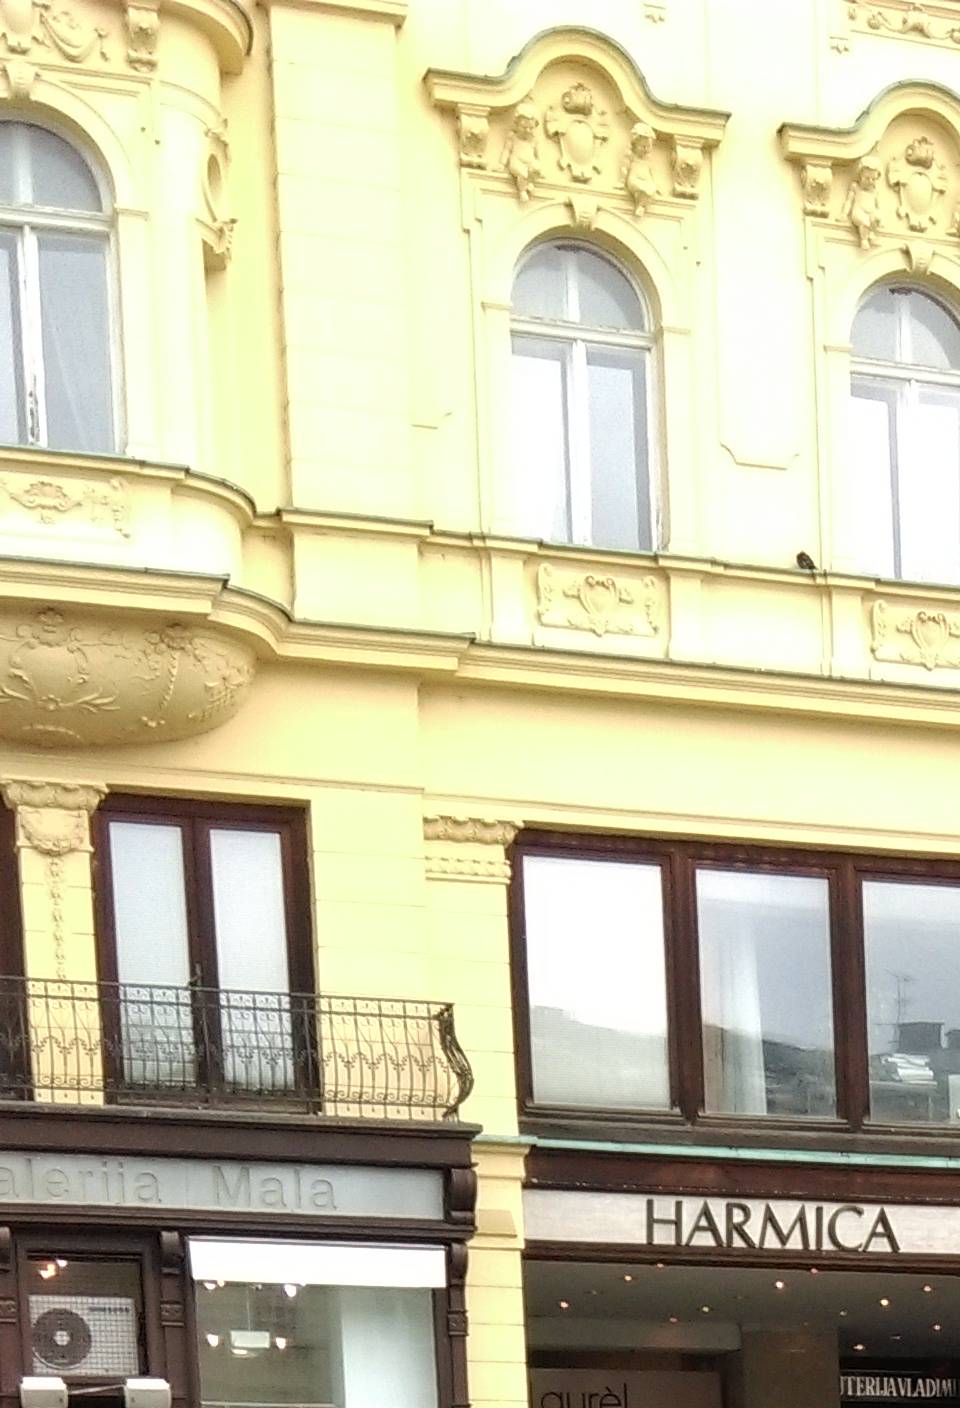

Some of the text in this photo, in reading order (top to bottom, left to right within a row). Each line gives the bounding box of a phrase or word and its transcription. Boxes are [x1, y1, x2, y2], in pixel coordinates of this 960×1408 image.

[0, 1158, 338, 1212] alerija Mala
[646, 1198, 901, 1253] HARMICA
